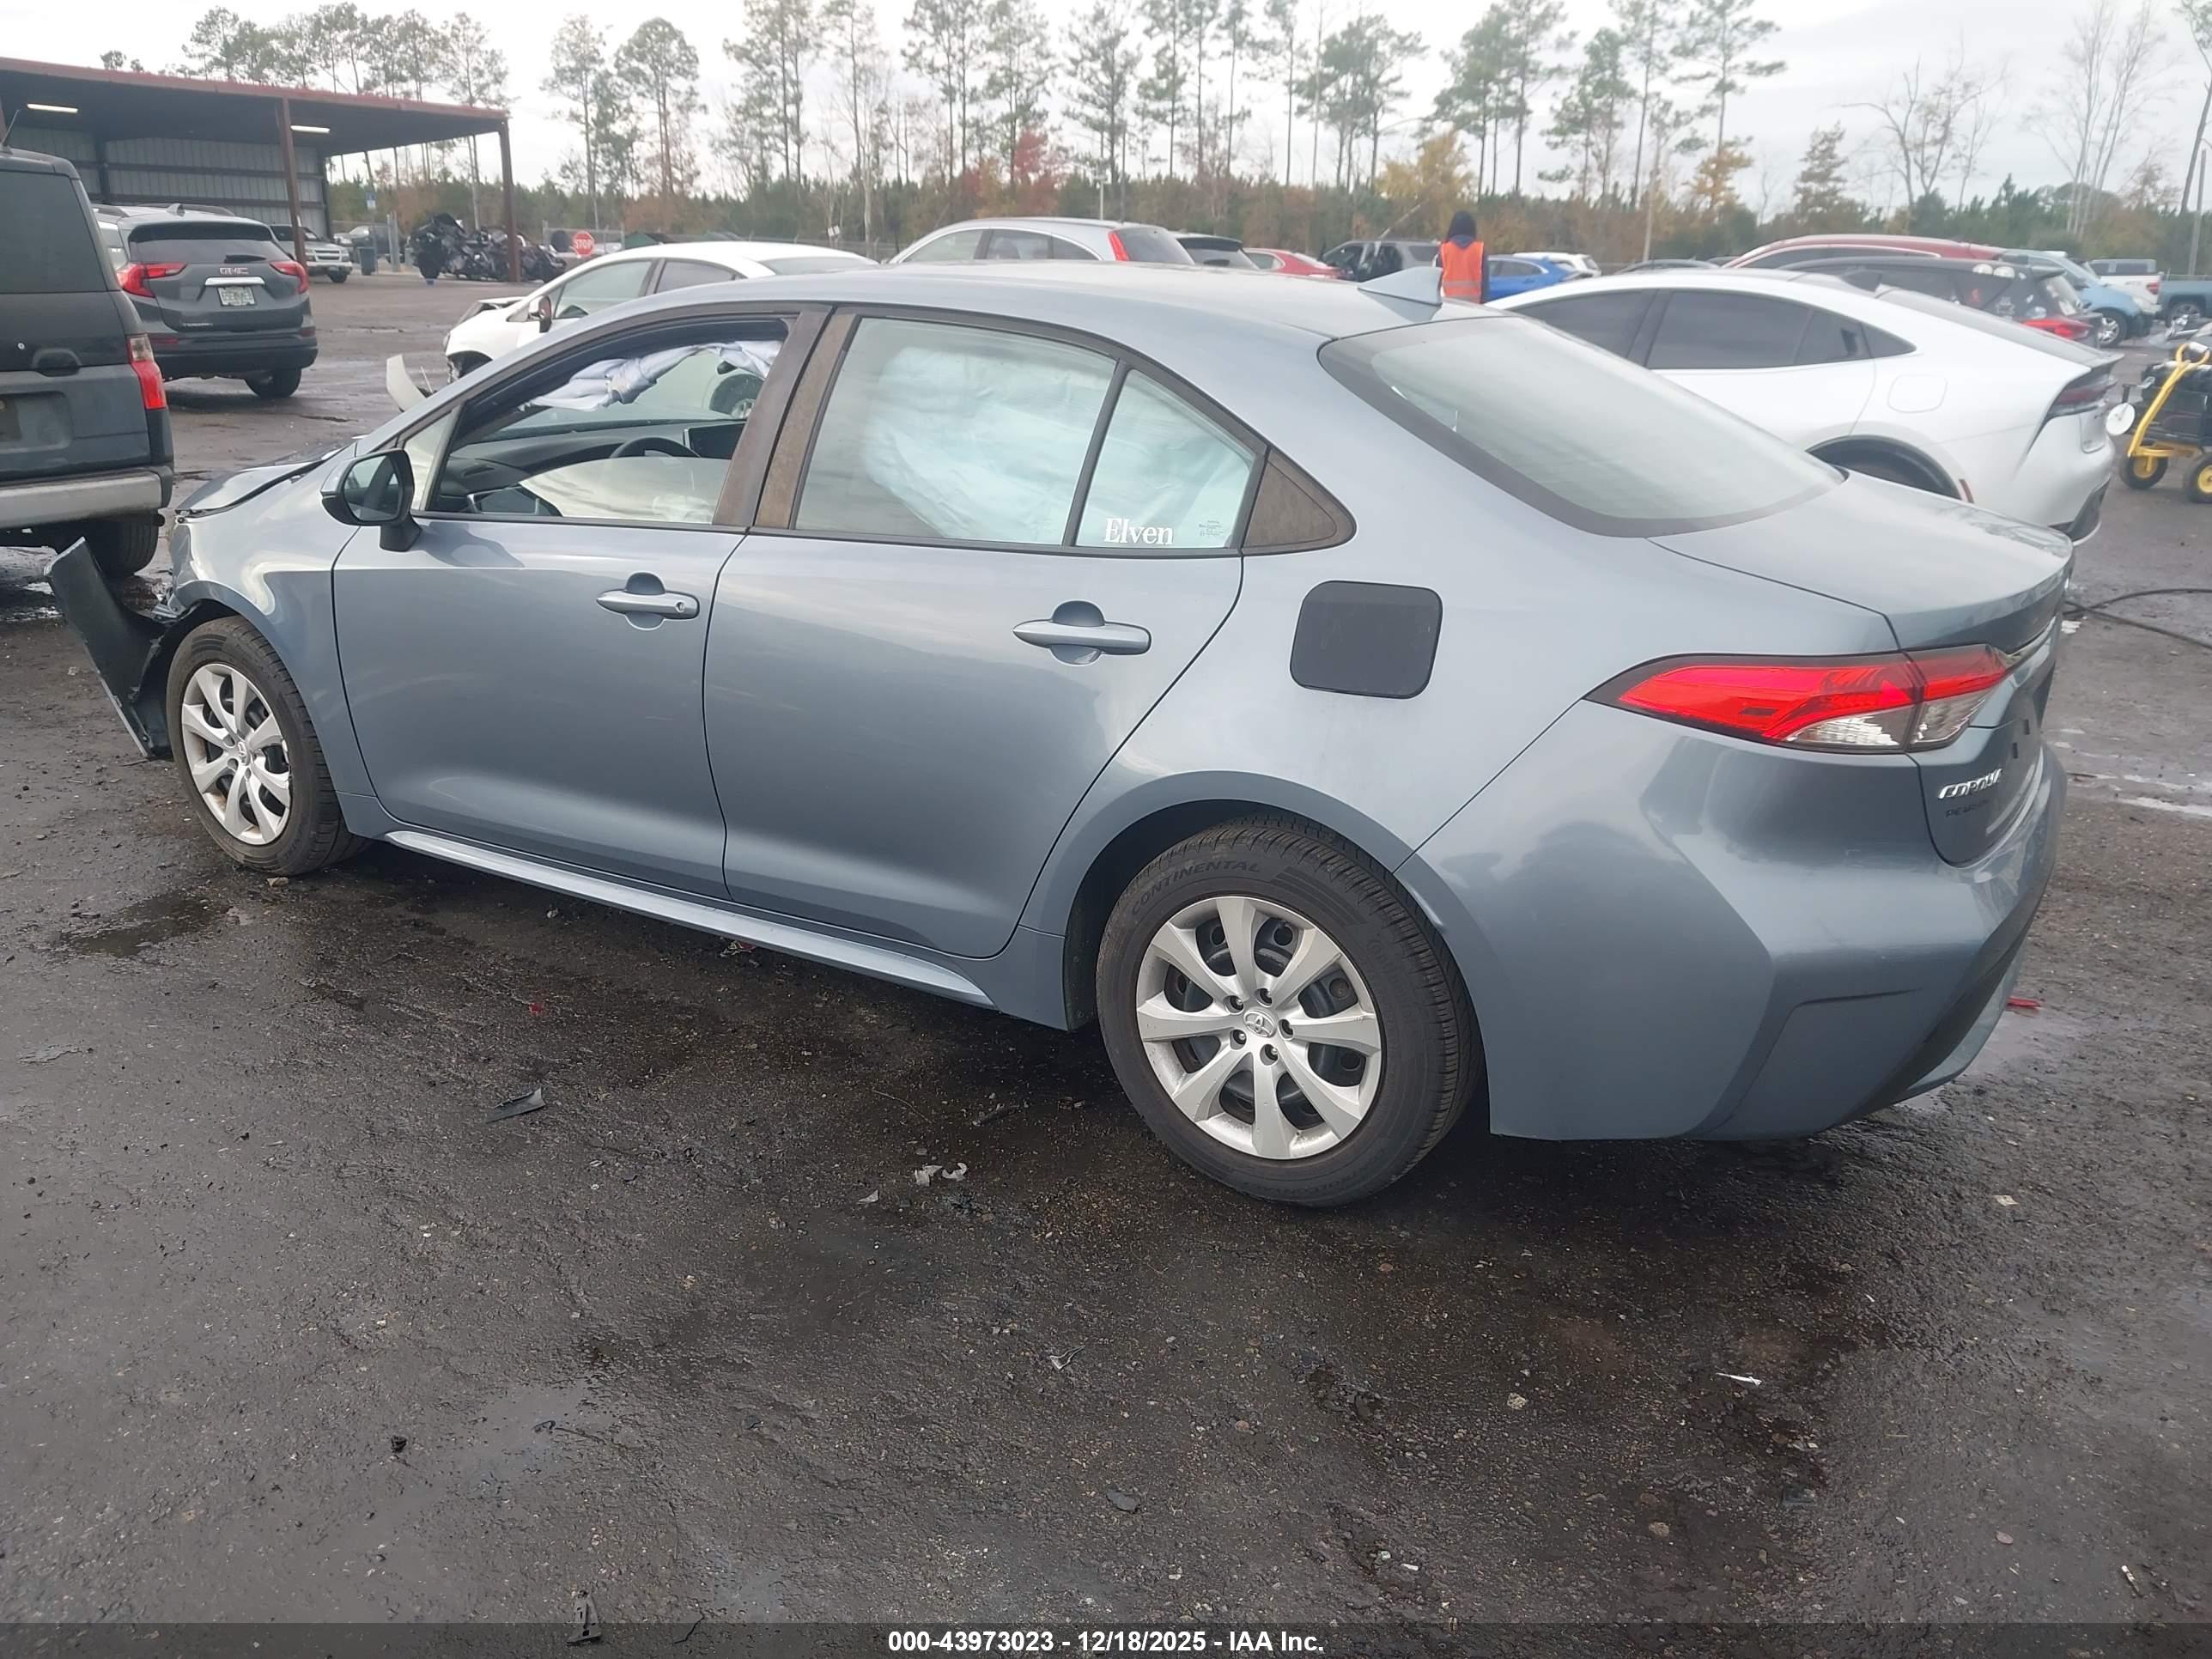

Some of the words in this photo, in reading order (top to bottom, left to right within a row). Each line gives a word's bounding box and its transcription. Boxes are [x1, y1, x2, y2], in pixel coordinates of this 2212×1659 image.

[574, 239, 592, 249] STOP
[1103, 518, 1173, 545] Elven
[1131, 860, 1261, 916] CONTINENTAL
